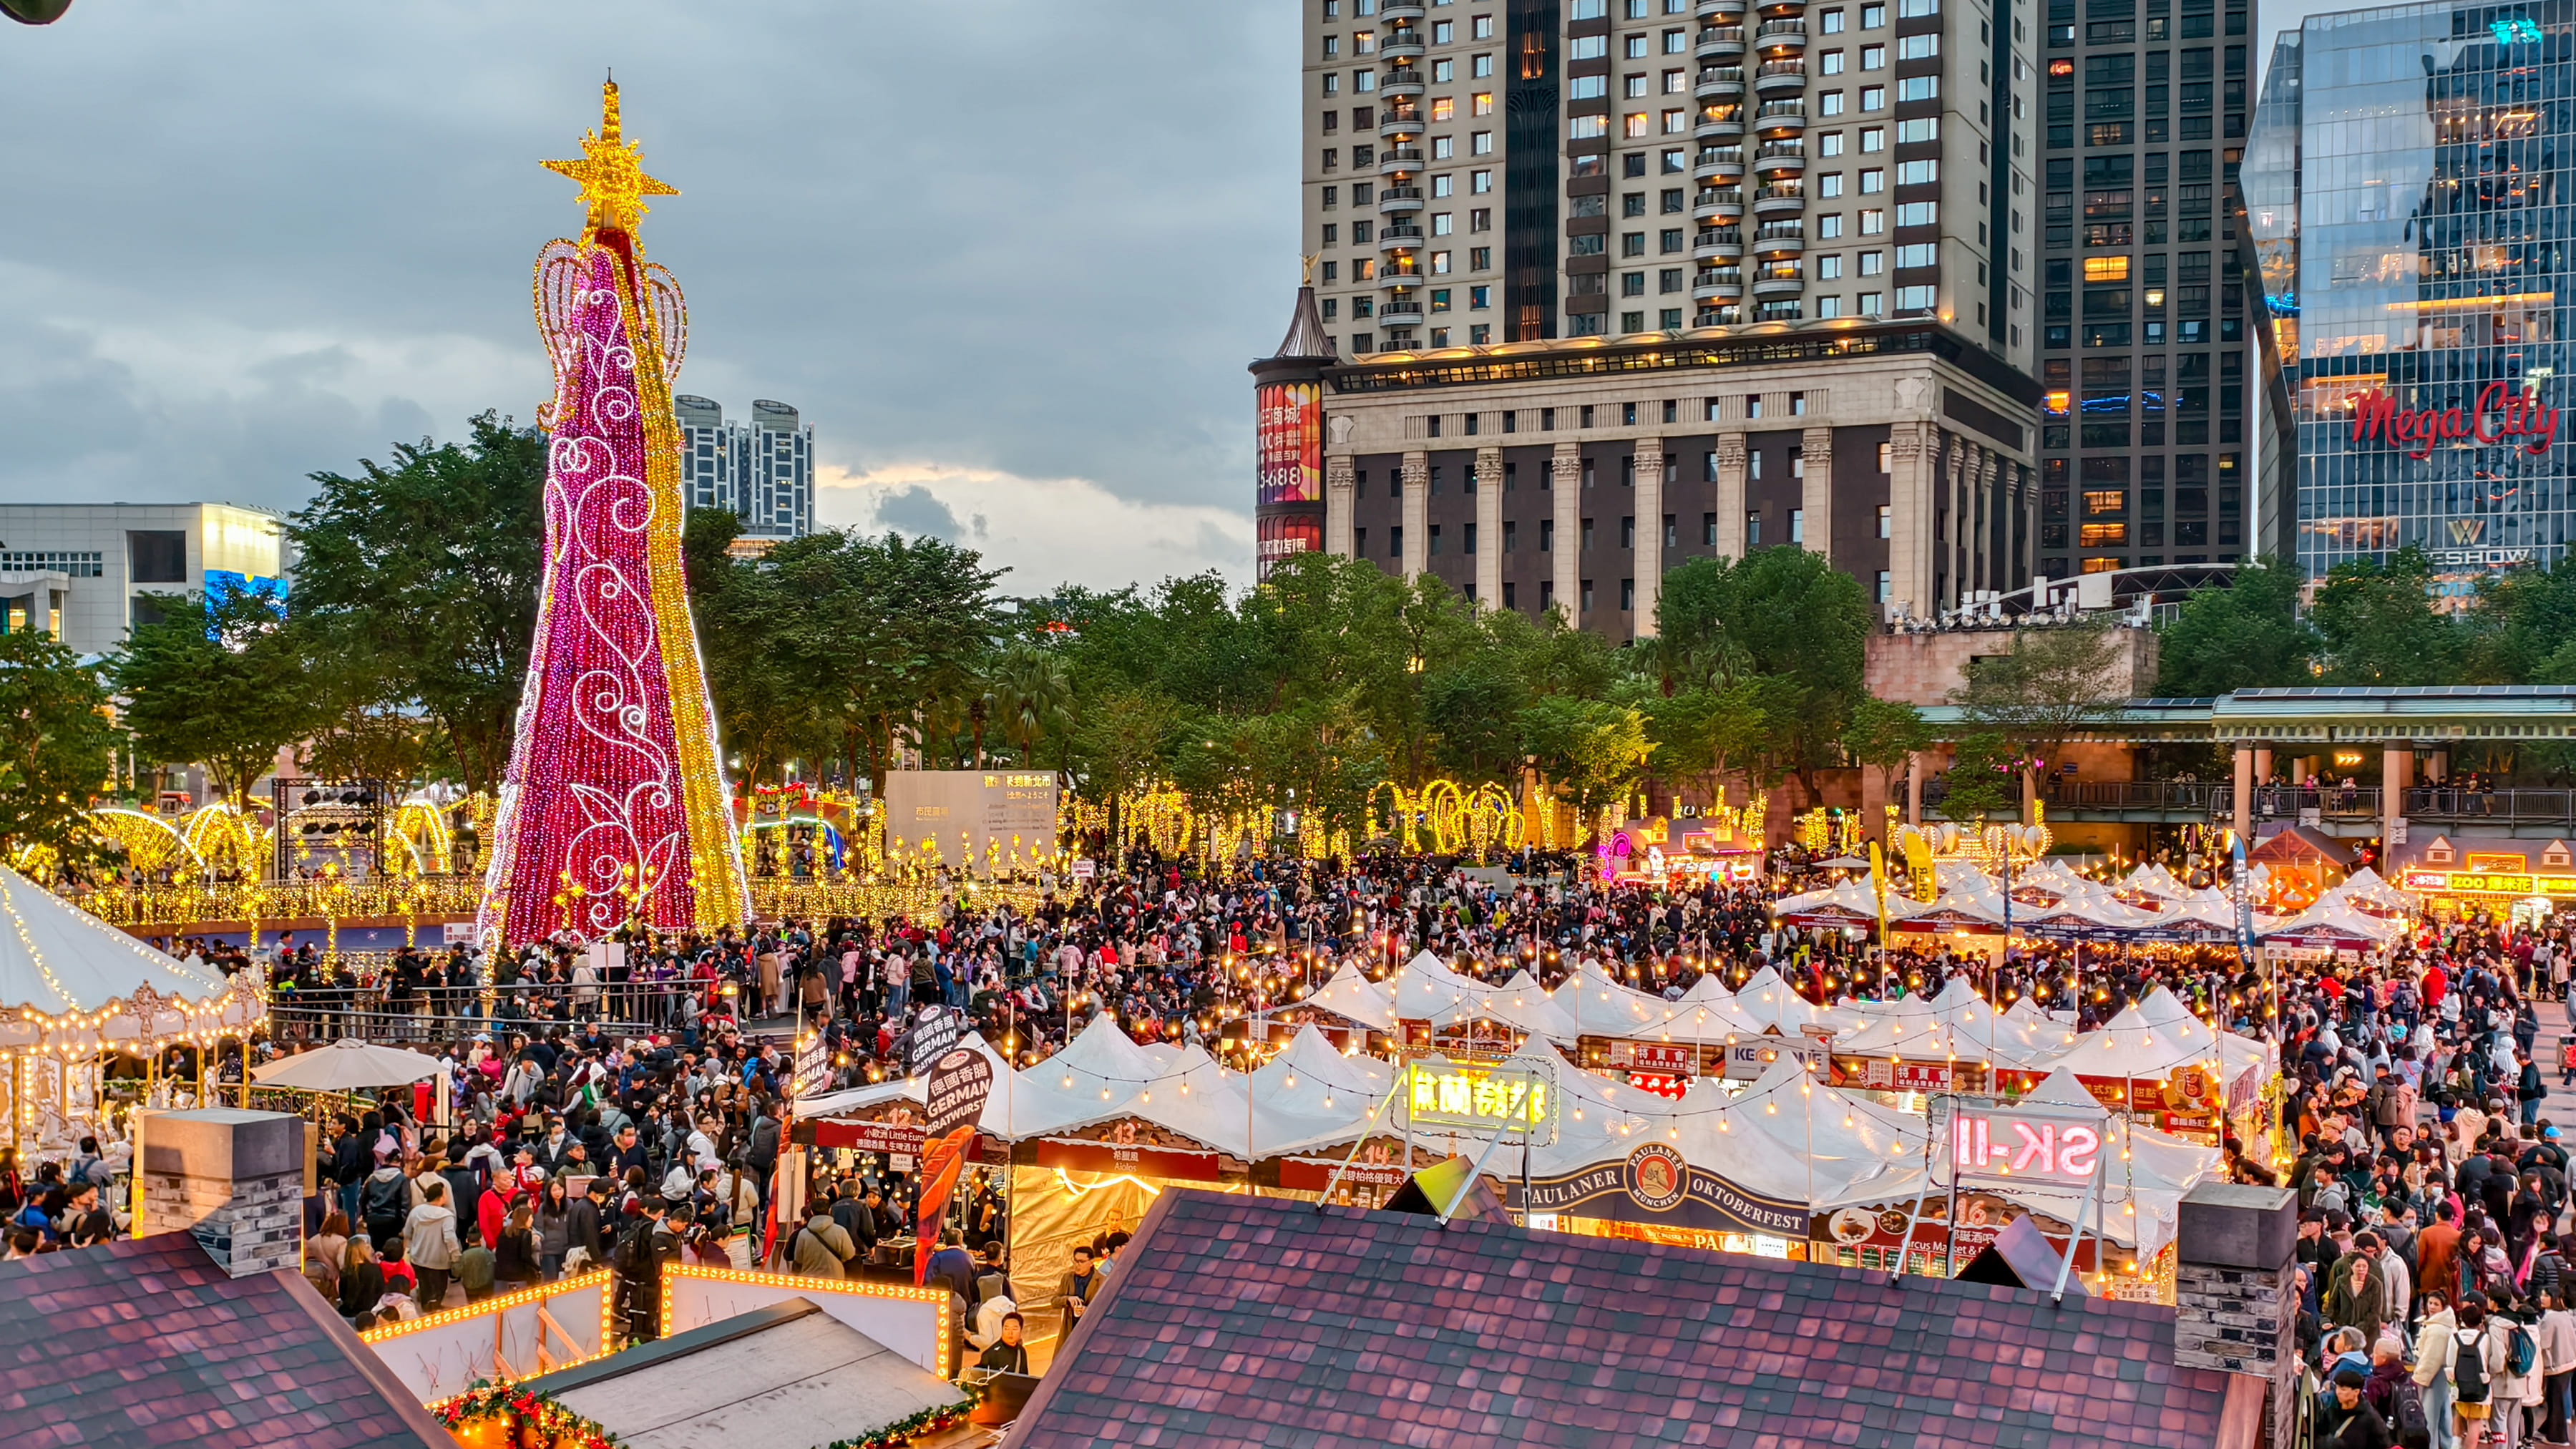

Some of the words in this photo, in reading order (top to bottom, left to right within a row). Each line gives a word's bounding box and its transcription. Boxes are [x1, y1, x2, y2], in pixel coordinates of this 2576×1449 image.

[2344, 389, 2472, 459] Mega
[2473, 381, 2558, 454] City
[2452, 877, 2485, 889] ZOO
[917, 1015, 954, 1045] 德國香腸
[912, 1029, 957, 1063] GERMAN
[789, 1061, 827, 1097] GRMAN
[930, 1061, 988, 1097] 德國香腸
[927, 1078, 990, 1118] GERMAN
[888, 1108, 911, 1128] 12
[925, 1098, 985, 1136] BRATWURST
[889, 1130, 907, 1140] Little
[1113, 1123, 1134, 1143] 13
[1365, 1145, 1390, 1166] 14
[1629, 1146, 1684, 1171] PAULANER
[1692, 1178, 1802, 1230] OKTOBERFEST
[1956, 1197, 1987, 1226] 16
[1901, 1238, 1931, 1249] Crcus
